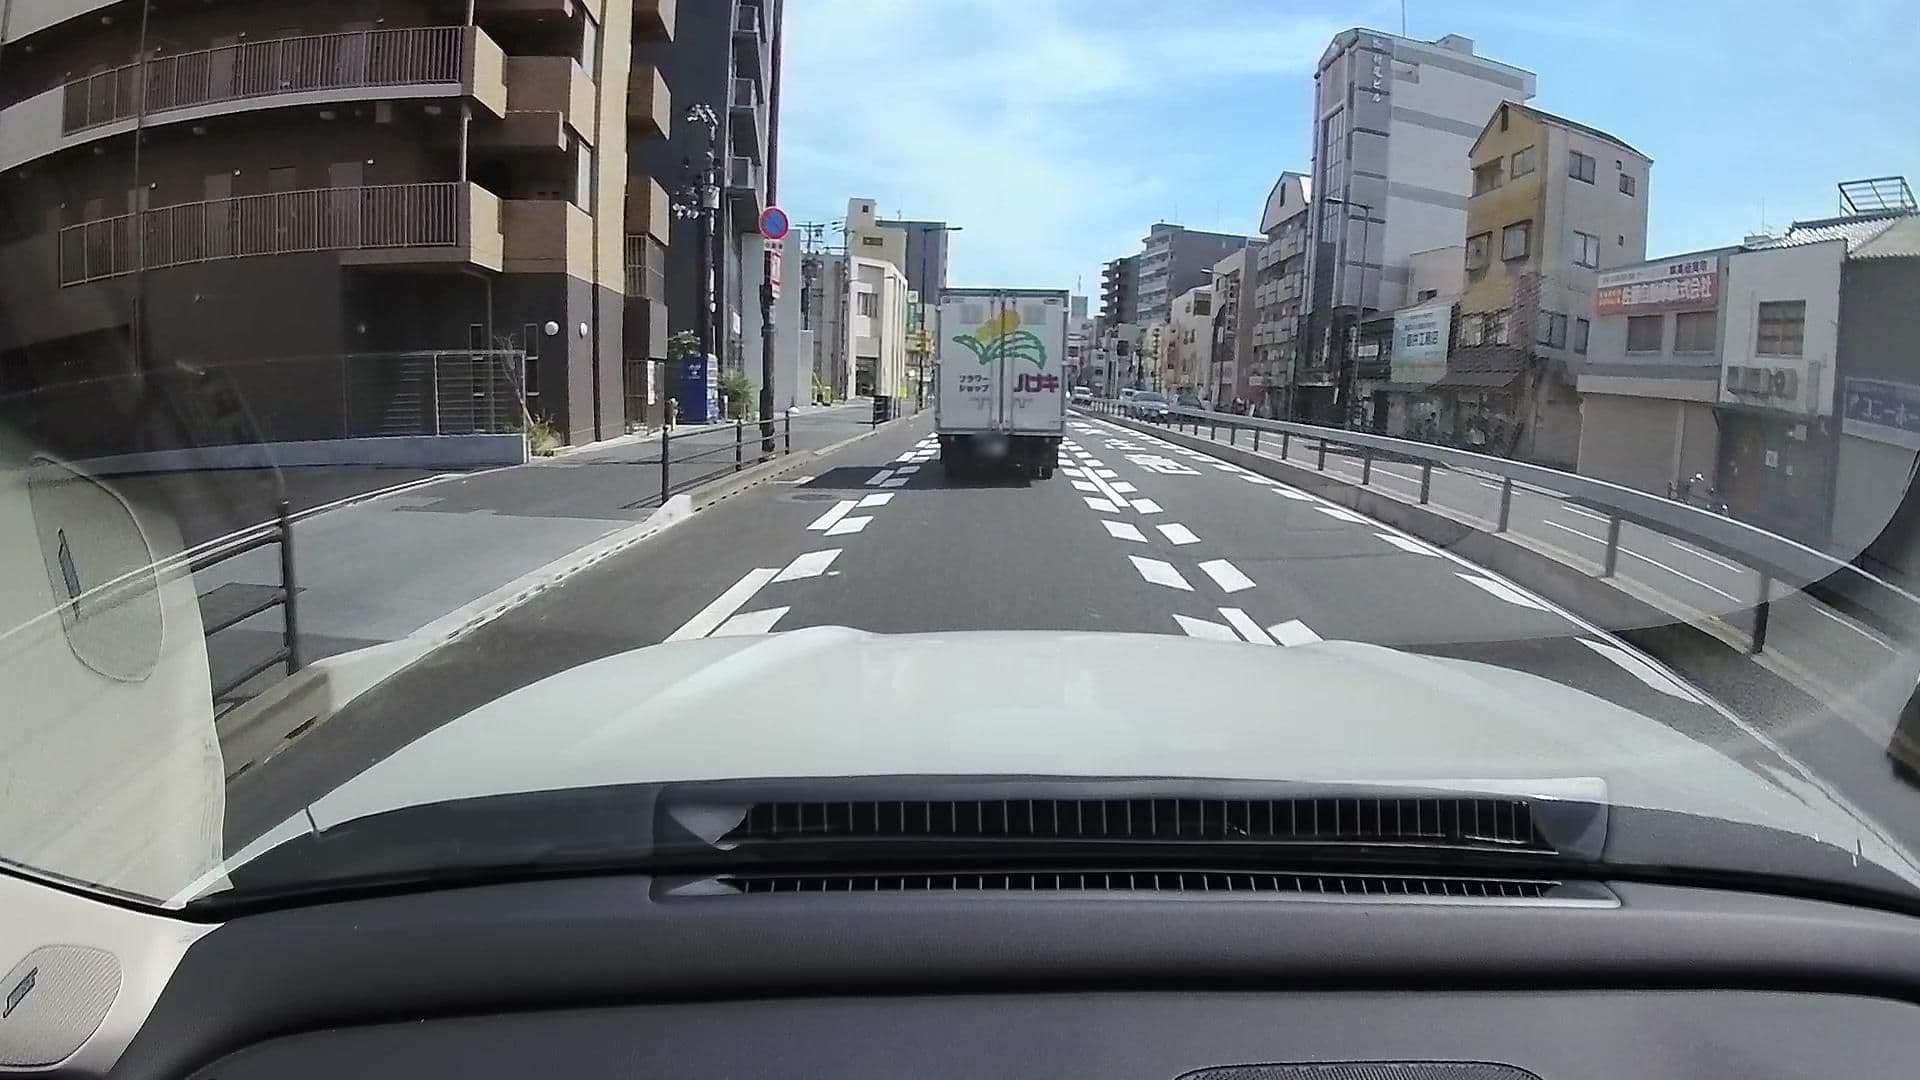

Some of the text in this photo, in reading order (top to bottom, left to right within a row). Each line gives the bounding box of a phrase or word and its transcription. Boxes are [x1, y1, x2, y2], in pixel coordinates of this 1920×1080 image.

[960, 374, 989, 383] フラワー
[960, 384, 989, 393] ショップ
